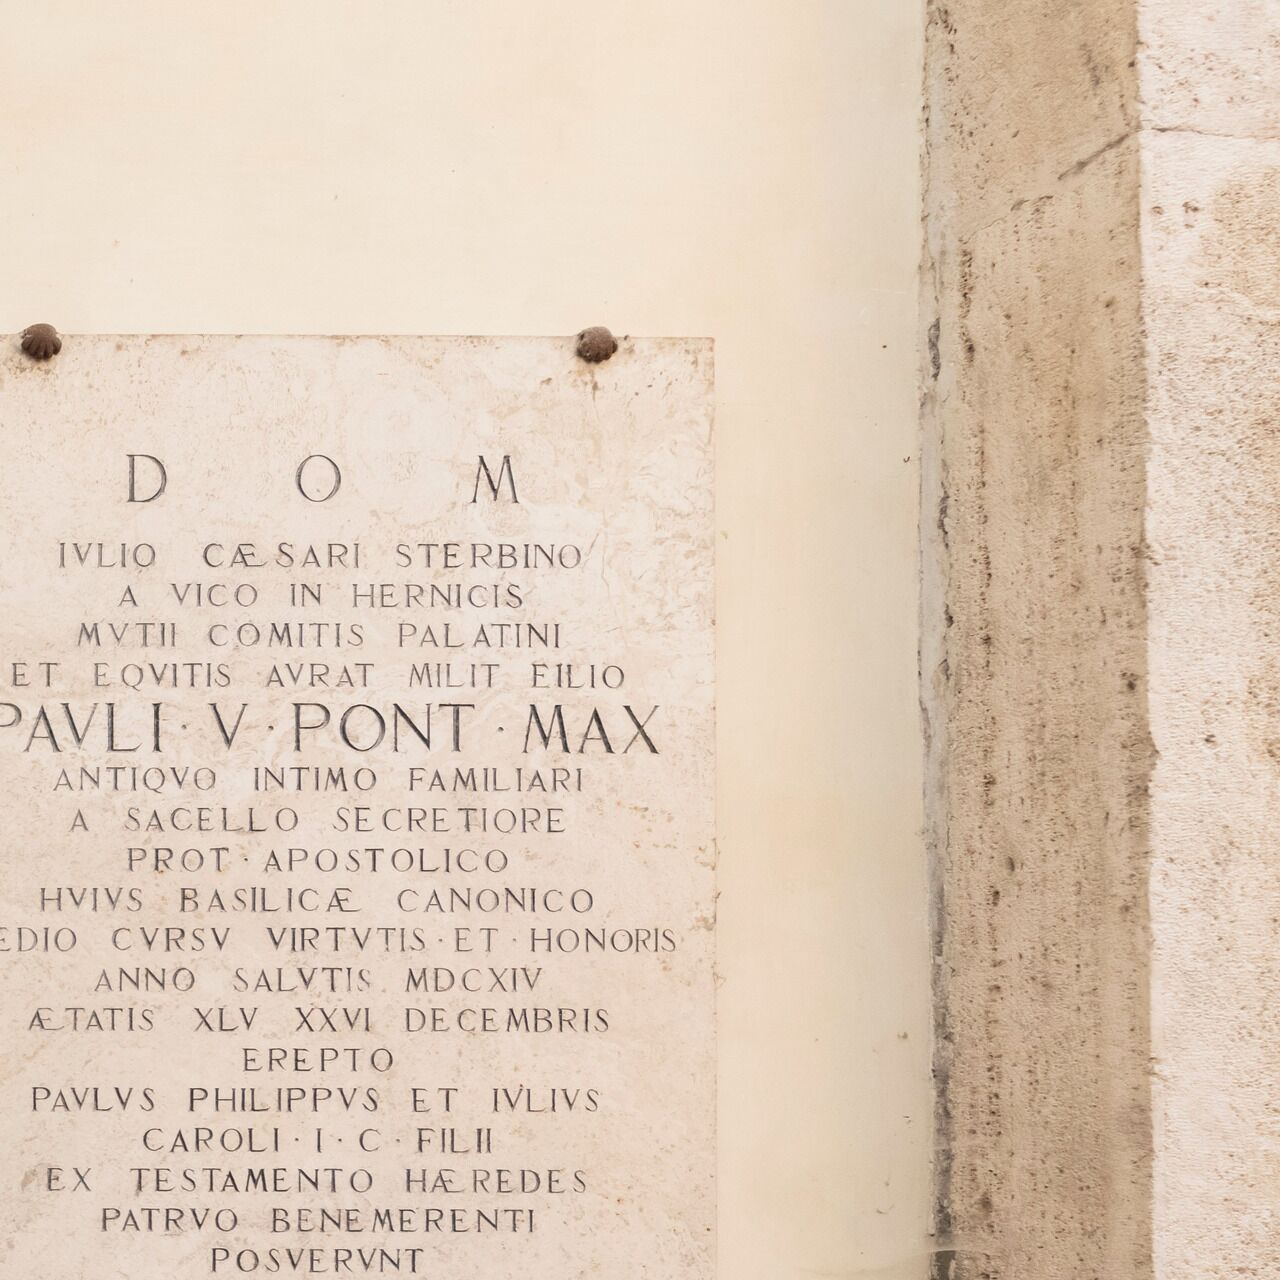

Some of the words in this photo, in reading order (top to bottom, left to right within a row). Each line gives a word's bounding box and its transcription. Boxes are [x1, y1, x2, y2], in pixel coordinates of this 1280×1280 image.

[59, 542, 156, 568] IVLIO
[396, 542, 582, 569] STERBINO
[118, 585, 138, 607] A
[171, 583, 258, 608] VICO
[290, 583, 322, 607] IN
[352, 583, 523, 609] HERNICIS
[77, 622, 176, 648] MVTII
[207, 622, 364, 648] COMITIS
[399, 622, 560, 649] PALATINI
[11, 662, 59, 688] ET
[94, 662, 231, 692] EQVITIS
[266, 662, 375, 688] AVRAT
[409, 662, 500, 688] MILIT
[53, 766, 216, 794] ANTIQVO
[254, 766, 377, 792] INTIMO
[409, 767, 582, 793] FAMILIARI
[70, 809, 89, 832] A
[127, 807, 299, 834] SACELLO
[336, 806, 565, 834] SECRETIORE
[40, 887, 143, 913] HVIVS
[397, 887, 594, 914] CANONICO
[111, 926, 230, 953] CVRSV
[94, 967, 196, 992] ANNO
[233, 967, 370, 993] SALVTIS
[405, 967, 542, 993] MDCXIV
[194, 1007, 258, 1032] XLV
[295, 1006, 370, 1033] XXVI
[405, 1007, 609, 1033] DECEMBRIS
[242, 1047, 394, 1073] EREPTO
[31, 1086, 155, 1112] PAVLVS
[188, 1087, 378, 1113] PHILIPPVS
[411, 1087, 459, 1113] ET
[492, 1087, 599, 1113] IVLIVS
[46, 1167, 92, 1192] EX
[130, 1167, 373, 1195] TESTAMENTO
[101, 1207, 238, 1233] PATRVO
[270, 1207, 534, 1233] BENEMERENTI
[211, 1247, 425, 1274] POSVERVNT
